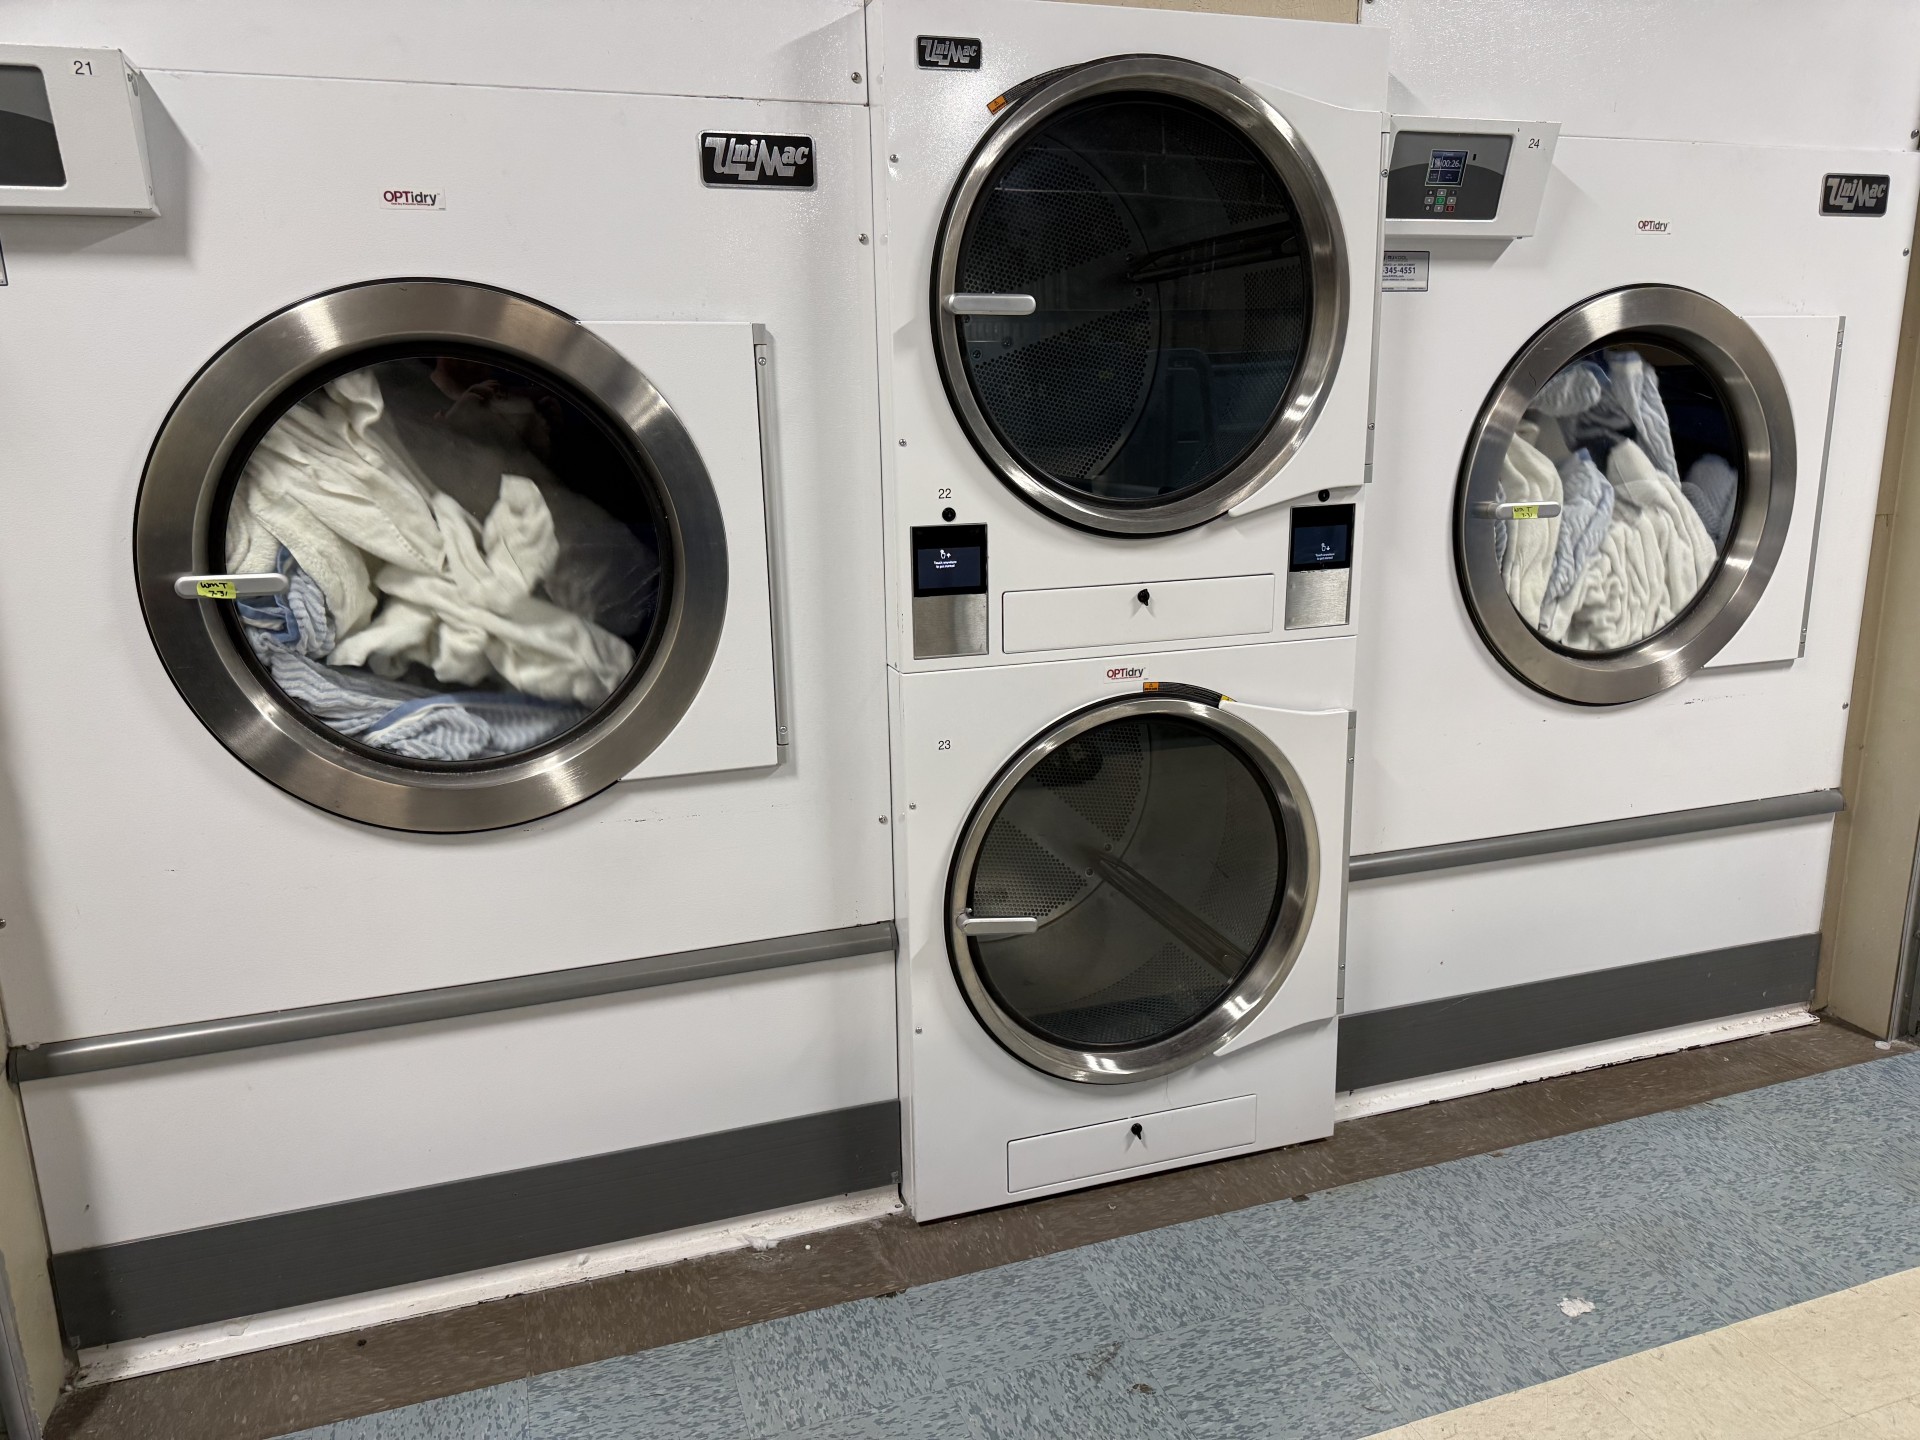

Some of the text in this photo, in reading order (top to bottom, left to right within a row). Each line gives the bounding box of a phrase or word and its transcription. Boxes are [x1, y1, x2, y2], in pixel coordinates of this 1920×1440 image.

[919, 39, 979, 66] UniMac
[73, 60, 93, 76] 21
[1528, 138, 1540, 149] 24
[704, 136, 810, 181] UniMac
[383, 190, 437, 206] OPTidry
[1826, 177, 1887, 211] UniMac
[1637, 220, 1668, 232] OPTidry
[938, 488, 952, 500] 22
[1106, 667, 1144, 679] OPTidry
[938, 739, 951, 751] 23
